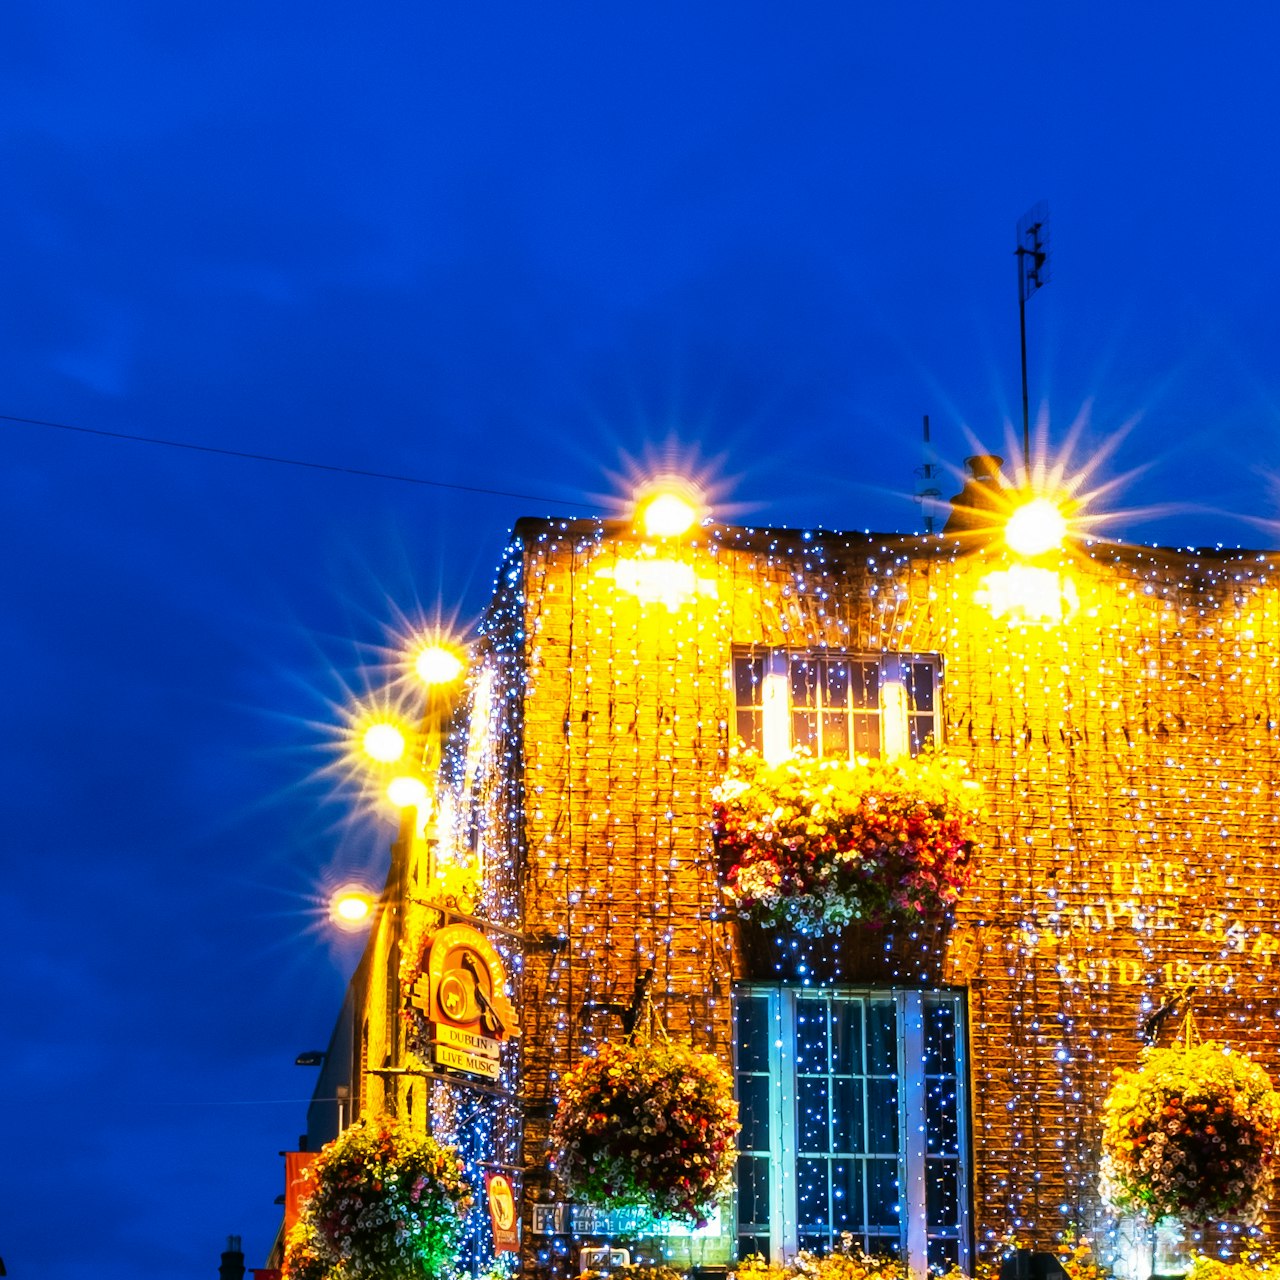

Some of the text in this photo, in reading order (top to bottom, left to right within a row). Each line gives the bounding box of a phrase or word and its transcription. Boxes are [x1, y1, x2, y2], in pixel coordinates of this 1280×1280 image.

[450, 1030, 488, 1050] DUBLIN
[442, 1052, 495, 1074] LIVE MUSIC
